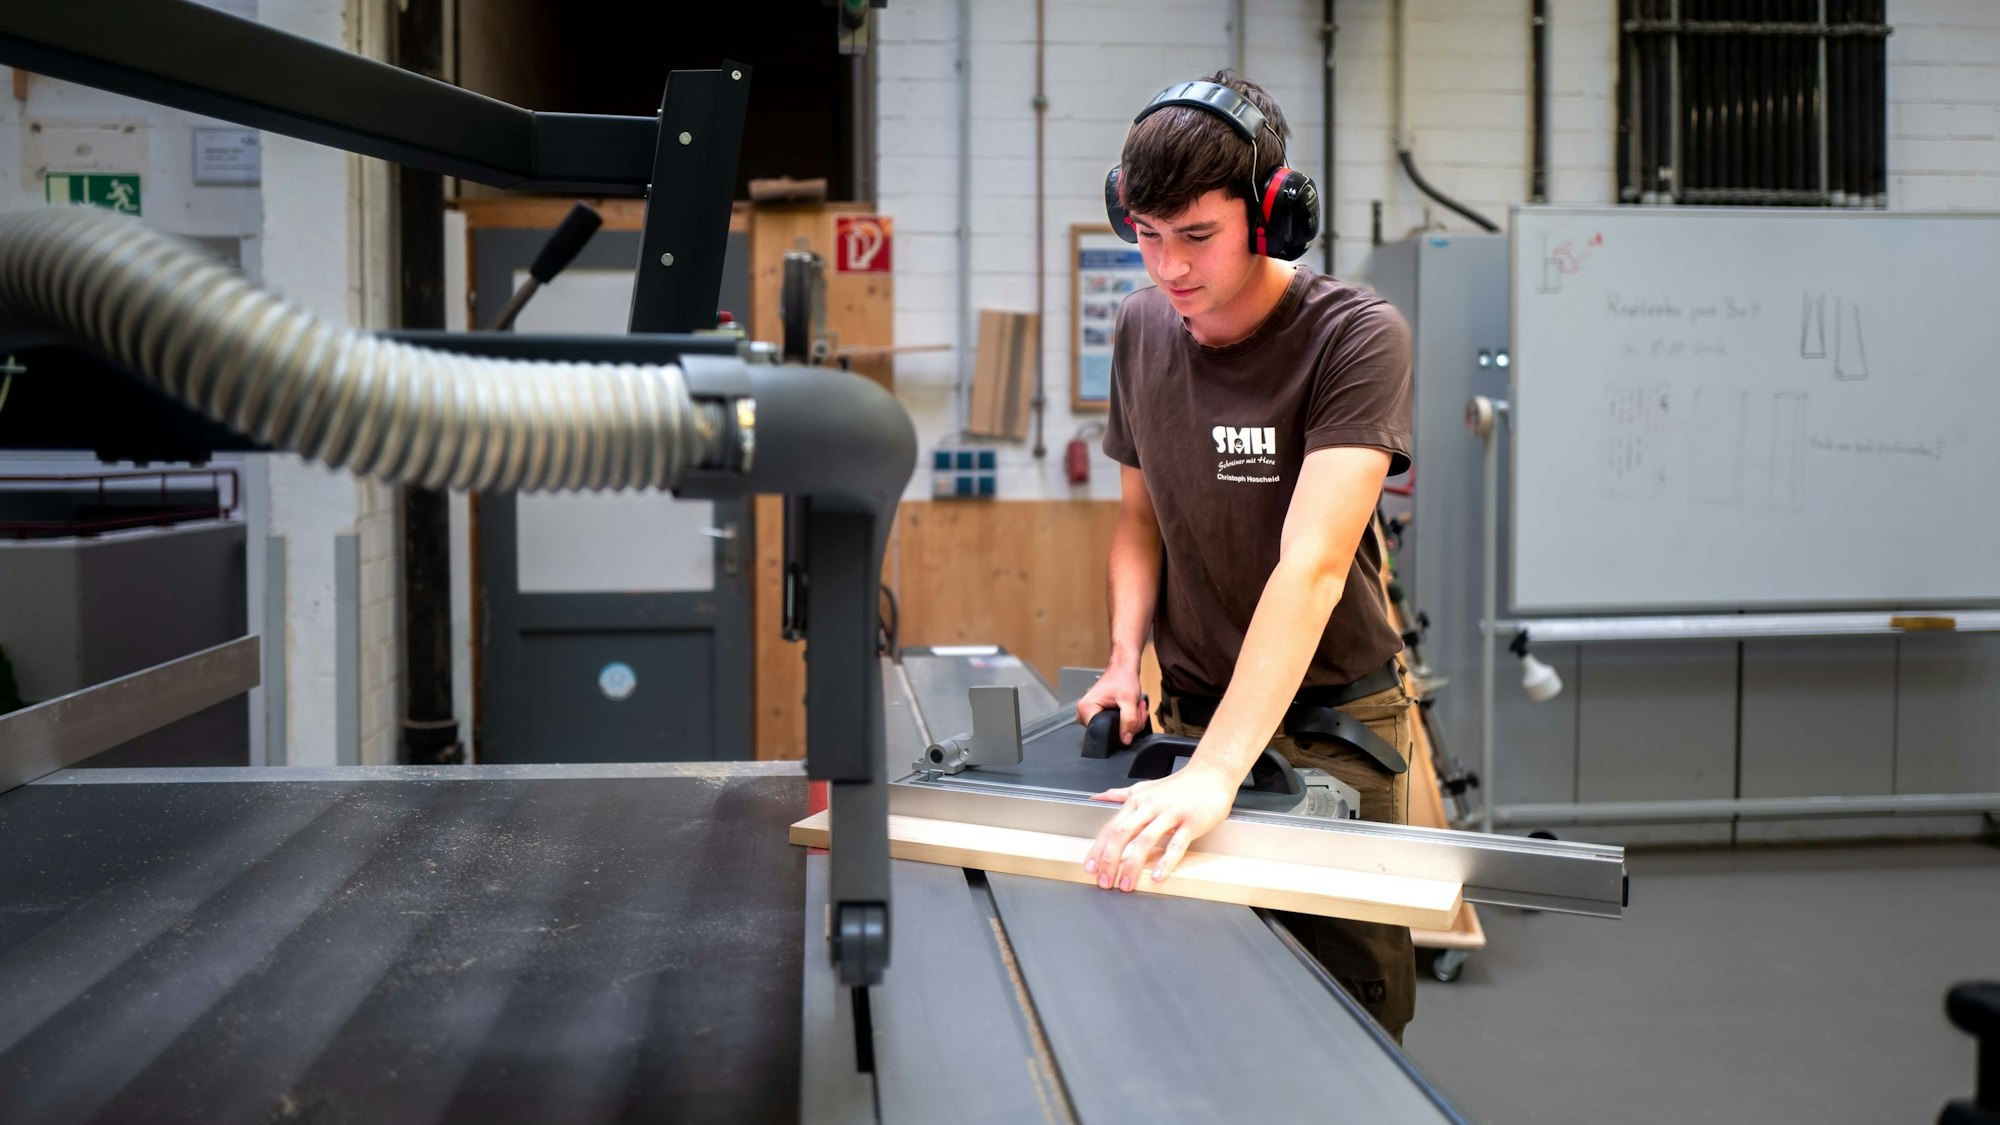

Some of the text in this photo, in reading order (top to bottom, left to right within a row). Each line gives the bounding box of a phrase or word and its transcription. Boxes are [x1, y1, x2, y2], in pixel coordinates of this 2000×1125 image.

[1212, 426, 1276, 454] SMH
[1218, 459, 1245, 472] Schreiner
[1257, 456, 1275, 465] Herz
[1217, 473, 1280, 483] Christoph Hoscheid
